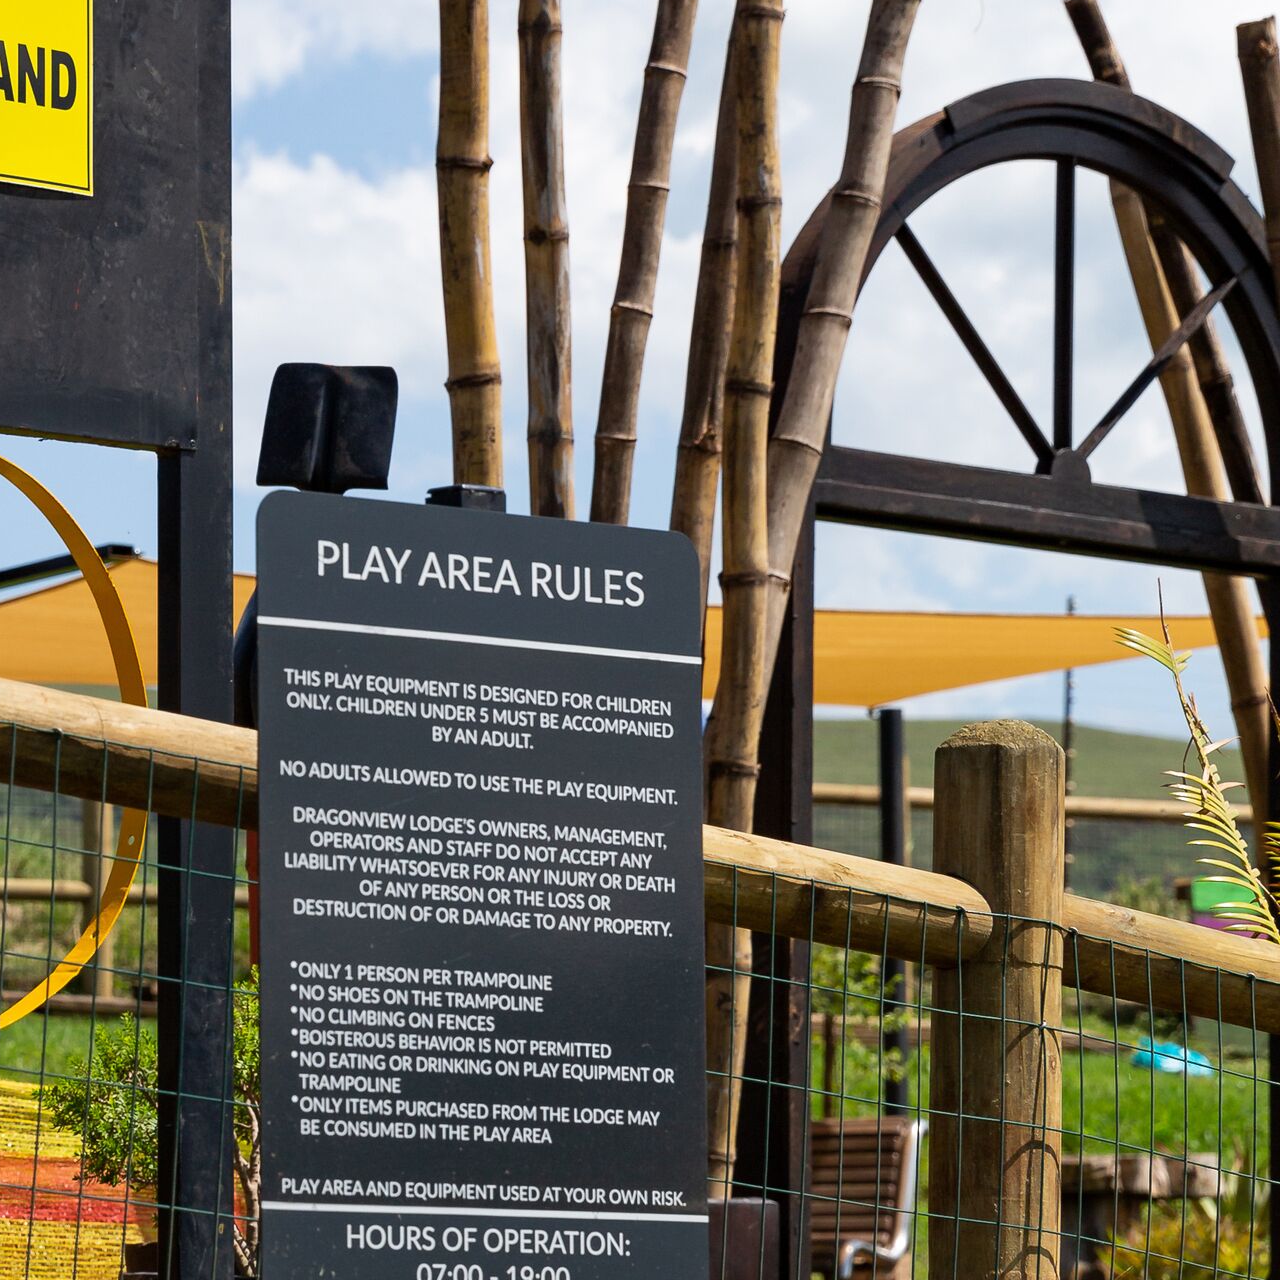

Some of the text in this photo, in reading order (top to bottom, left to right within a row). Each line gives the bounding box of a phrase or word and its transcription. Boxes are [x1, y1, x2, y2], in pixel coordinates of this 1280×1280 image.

[317, 539, 645, 607] PLAY AREA RULES
[283, 667, 672, 717] THIS PLAY EQUIPMENT IS DESIGNED FOR CHILDREN
[285, 690, 674, 739] ONLY. CHILDREN UNDER 5 MUST BE ACCOMPANIED
[431, 725, 534, 750] BY AN ADULT.
[279, 759, 678, 805] NO ADULTS ALLOWED TO USE THE PLAY EQUIPMENT.
[292, 805, 406, 830] DRAGONVIEW
[478, 818, 551, 842] OWNERS,
[553, 824, 667, 850] MANAGEMENT,
[309, 829, 653, 869] OPERATORS AND STAFF DO NOT ACCEPT ANY
[284, 851, 676, 893] LIABILITY WHATSOEVER FOR ANY INJURY OR DEATH
[358, 878, 611, 911] OF ANY PERSON OR THE LOSS OR
[292, 897, 673, 937] DESTRUCTION OF OR DAMAGE TO ANY PROPERTY.
[343, 963, 353, 981] 1
[356, 964, 419, 984] PERSON
[422, 967, 452, 985] PER
[453, 969, 553, 991] TRAMPOLINE
[327, 984, 381, 1004] SHOES
[382, 987, 409, 1005] ON
[410, 989, 442, 1007] THE
[444, 991, 544, 1013] TRAMPOLINE
[327, 1007, 406, 1028] CLIMBING
[407, 1011, 434, 1029] ON
[436, 1012, 495, 1032] FENCES
[398, 1033, 476, 1052] BEHAVIOR
[478, 1037, 492, 1053] IS
[494, 1038, 527, 1055] NOT
[529, 1039, 612, 1059] PERMITTED
[298, 1072, 401, 1094] TRAMPOLINE
[328, 1051, 386, 1071] EATING
[388, 1054, 413, 1072] OR
[415, 1055, 492, 1075] DRINKING
[494, 1059, 520, 1076] ON
[522, 1060, 560, 1078] PLAY
[562, 1062, 651, 1082] EQUIPMENT
[651, 1067, 675, 1084] OR
[345, 1097, 393, 1116] ITEMS
[395, 1099, 489, 1120] PURCHASED
[492, 1103, 537, 1121] FROM
[539, 1105, 570, 1123] THE
[573, 1107, 624, 1125] LODGE
[627, 1109, 660, 1126] MAY
[299, 1118, 553, 1144] BE CONSUMED IN THE PLAY AREA
[281, 1177, 687, 1207] PLAY AREA AND EQUIPMENT USED AT YOUR OWN RISK.
[346, 1223, 631, 1257] HOURS OF OPERATION:
